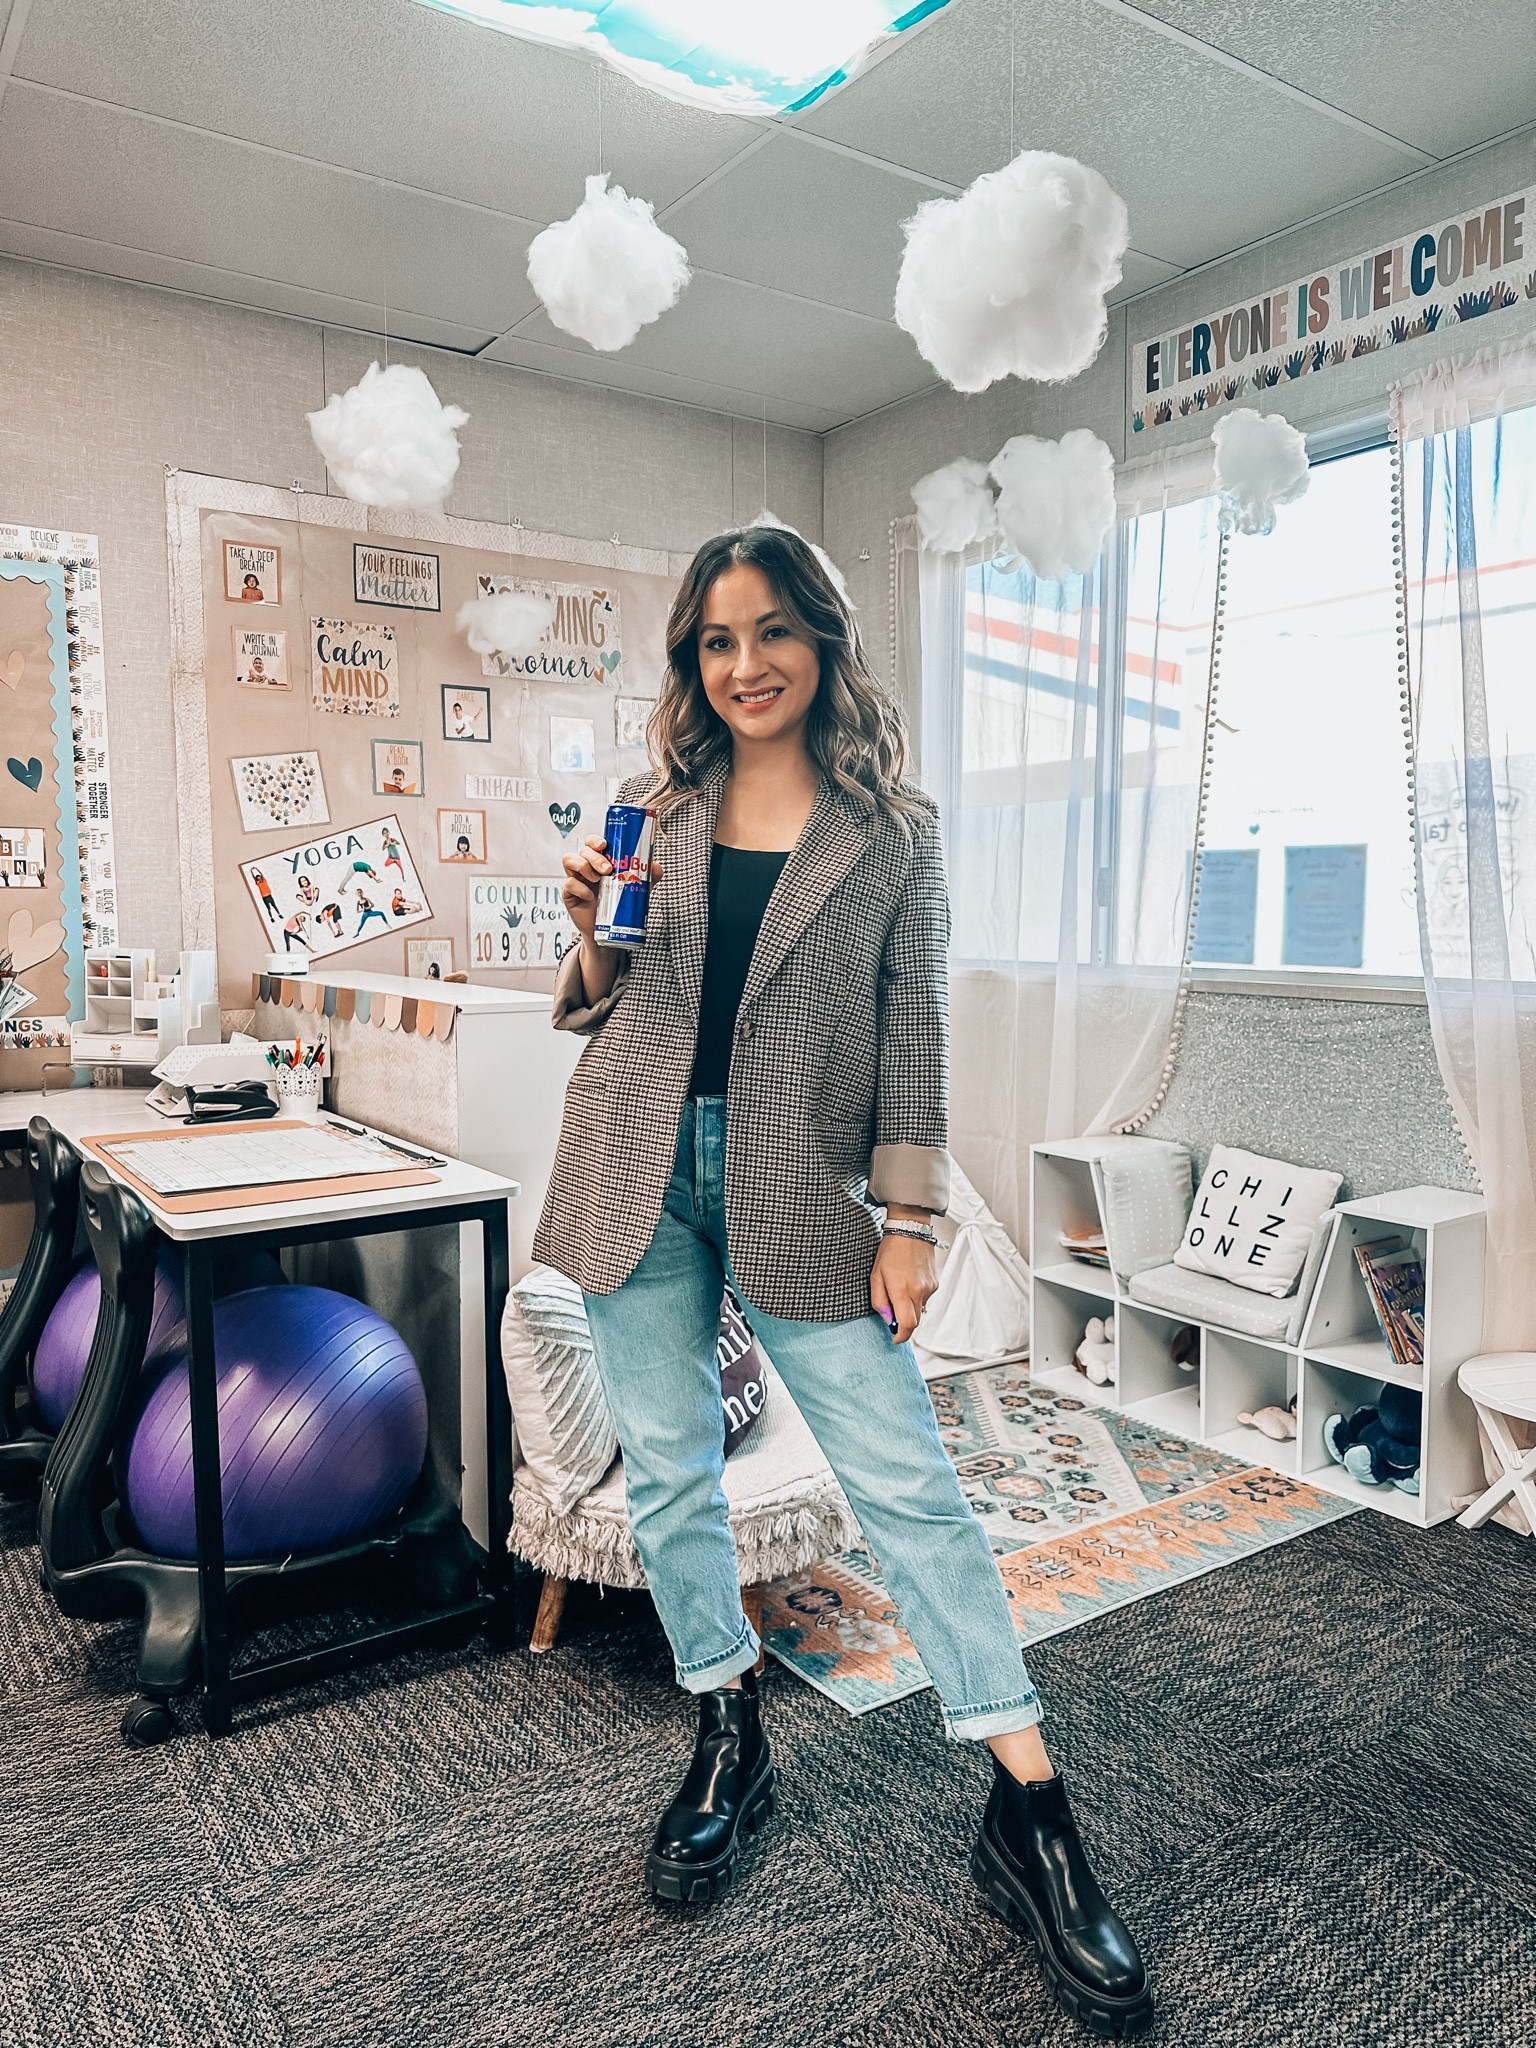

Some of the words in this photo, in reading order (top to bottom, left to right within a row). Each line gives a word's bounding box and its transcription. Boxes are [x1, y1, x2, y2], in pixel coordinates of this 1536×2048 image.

[1147, 290, 1289, 394] EVERYONE
[1298, 275, 1330, 339] IS
[1340, 197, 1526, 322] WELCOME
[0, 527, 18, 536] YOU
[30, 530, 59, 543] BELIEVE
[229, 546, 246, 559] TAKE
[250, 549, 254, 560] A
[257, 550, 274, 563] DEEP
[239, 558, 265, 572] BREATH
[361, 552, 386, 574] YOUR
[389, 557, 432, 580] FEELINGS
[84, 570, 92, 591] NICE
[361, 575, 434, 603] Matter
[79, 605, 92, 624] BIG
[91, 602, 100, 629] DREAM
[80, 636, 88, 663] CHANGE
[243, 633, 266, 646] WRITE
[268, 635, 276, 647] IN
[241, 643, 247, 655] A
[250, 644, 280, 657] JOURNAL
[317, 633, 391, 671] Calm
[83, 672, 94, 701] BELONG
[93, 680, 103, 695] YOU
[321, 665, 389, 699] MIND
[390, 744, 405, 755] READ
[86, 747, 97, 773] MATTER
[386, 755, 391, 766] A
[393, 755, 410, 766] BOOK
[476, 778, 531, 799] INHALE
[88, 782, 99, 819] TOGETHER
[98, 782, 108, 819] STRONGER
[455, 813, 463, 824] DO
[465, 814, 470, 825] A
[553, 807, 578, 826] and
[451, 823, 473, 835] PUZZLE
[2, 841, 25, 854] BE
[283, 834, 363, 874] YOGA
[103, 861, 111, 879] YOU
[605, 854, 629, 870] ed
[103, 888, 114, 915] BELIEVE
[475, 885, 563, 905] COUNTIN
[476, 931, 492, 962] 10
[502, 932, 511, 962] 9
[519, 932, 528, 962] 8
[536, 932, 545, 961] 7
[555, 931, 563, 961] 6
[1393, 1268, 1408, 1284] GUY
